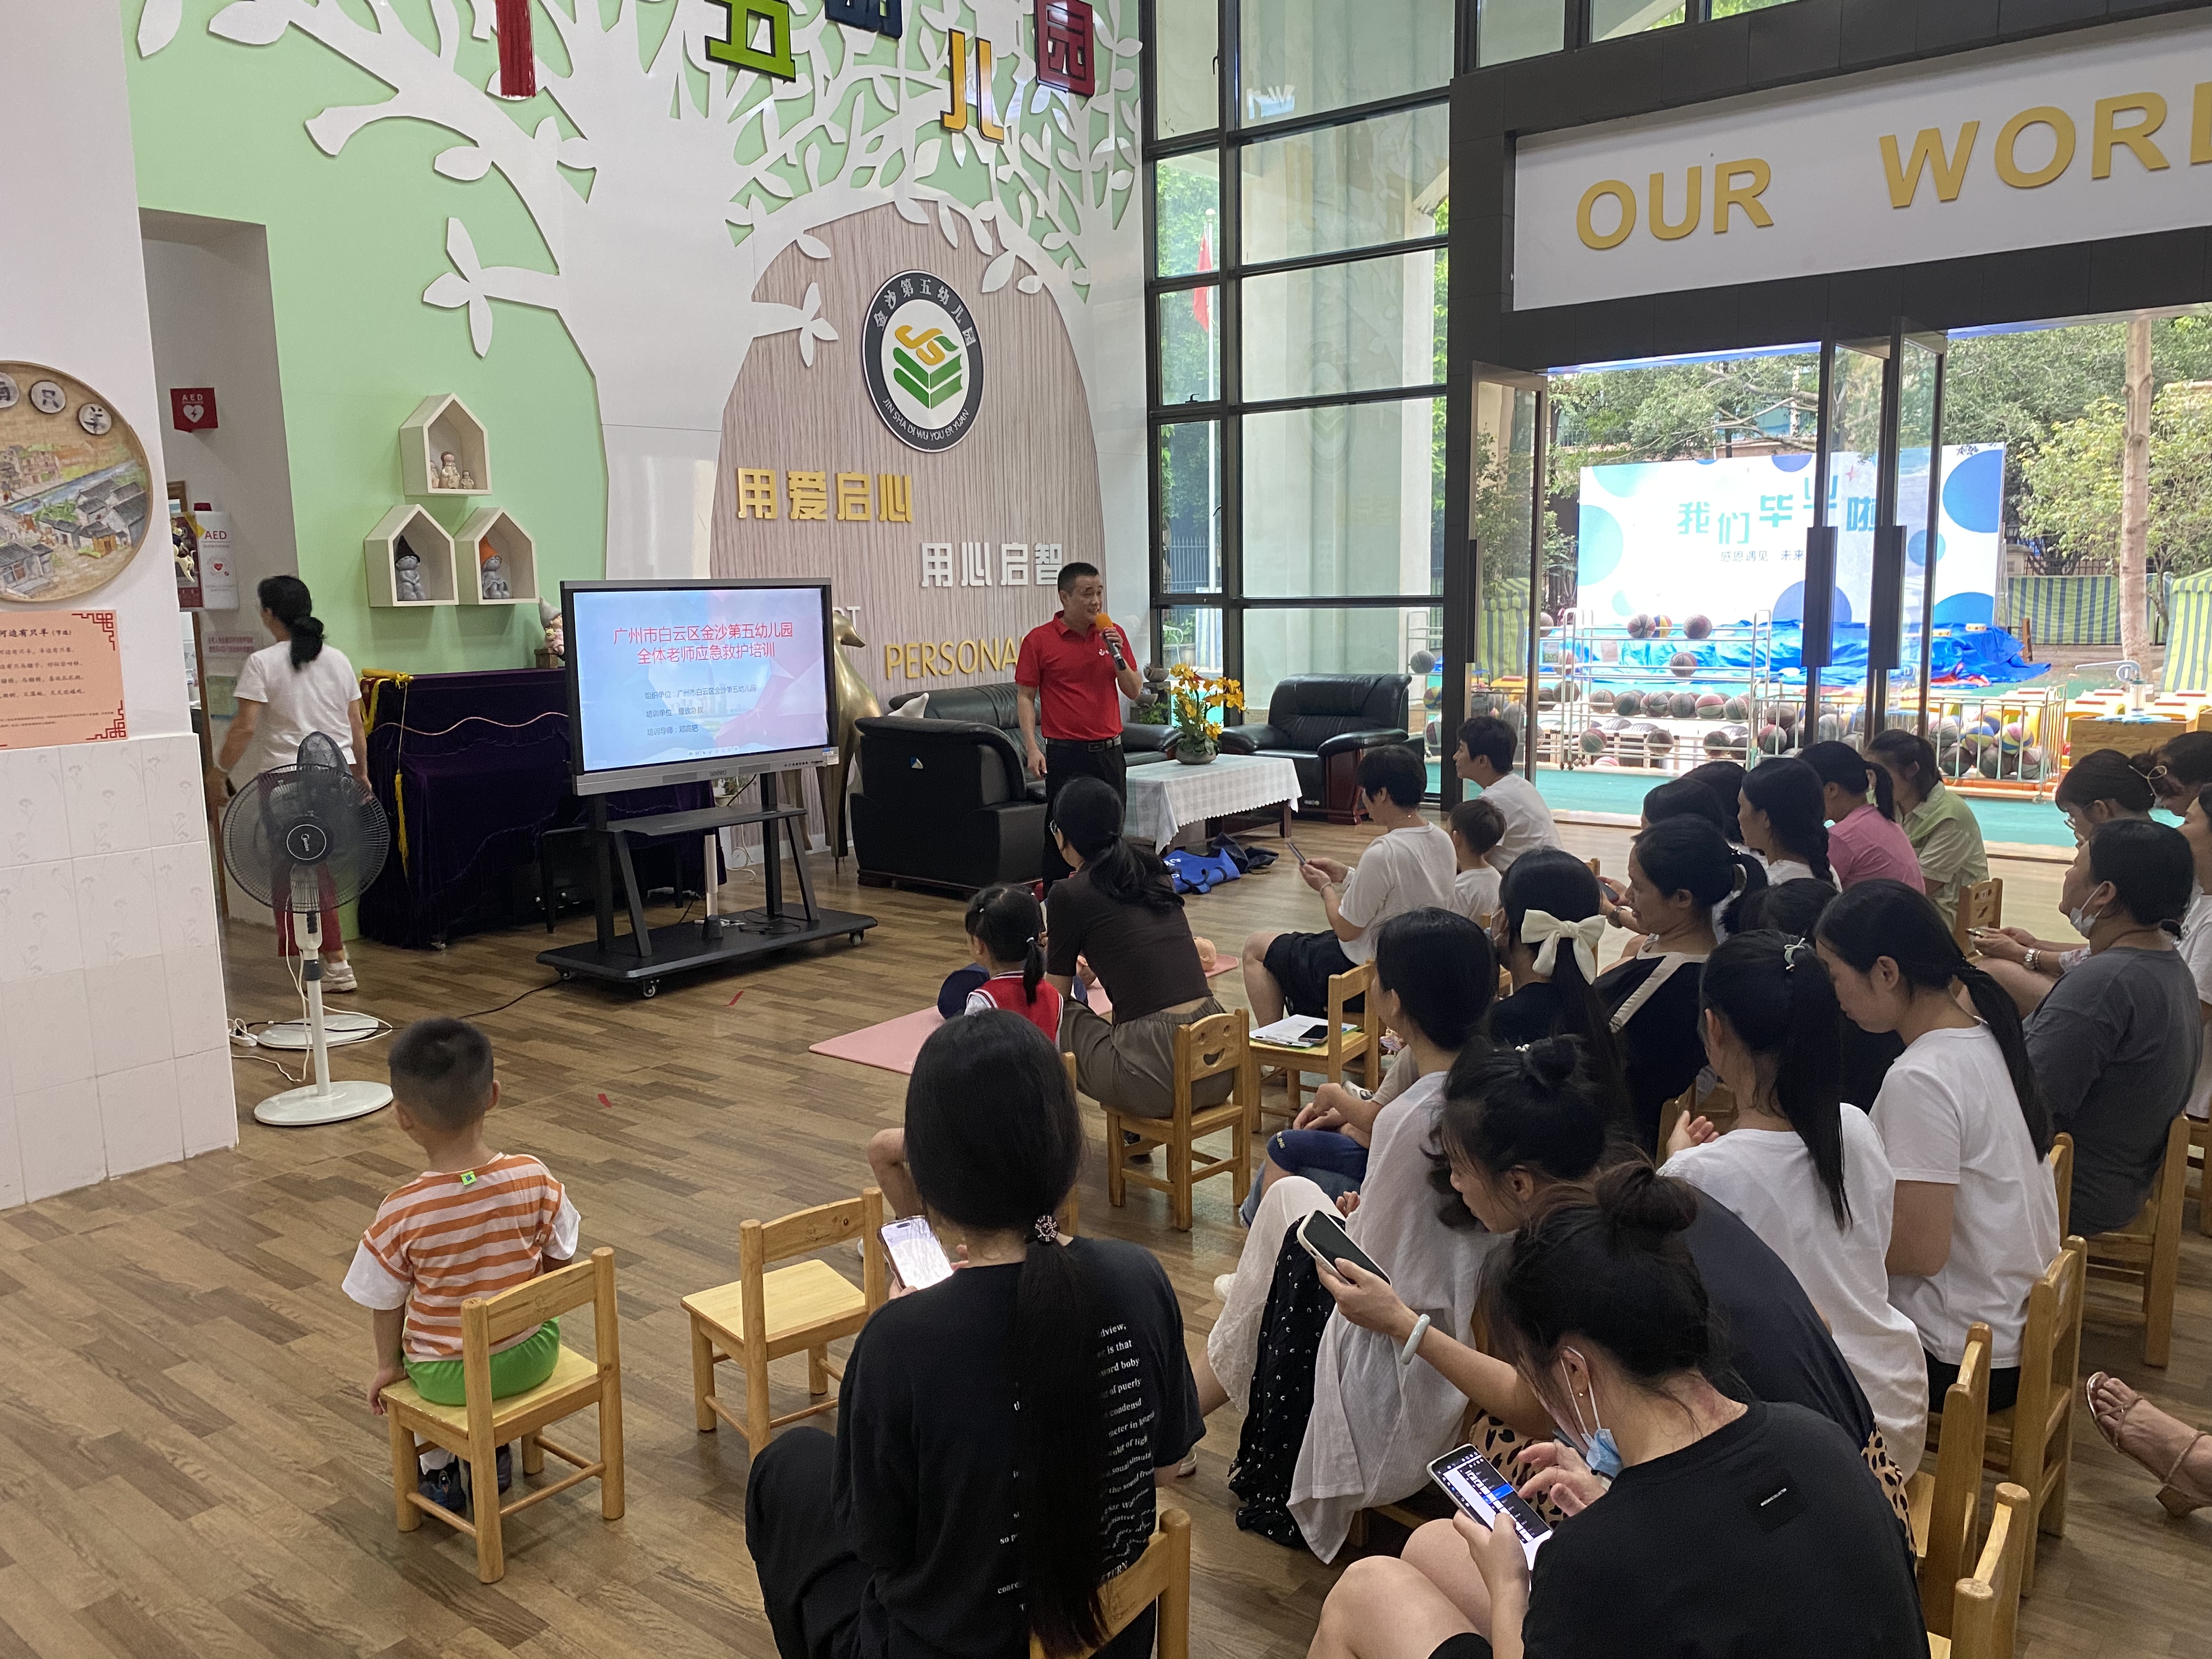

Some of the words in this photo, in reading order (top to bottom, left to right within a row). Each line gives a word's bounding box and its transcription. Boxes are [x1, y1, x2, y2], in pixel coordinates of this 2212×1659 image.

[1576, 157, 1774, 250] OUR
[873, 278, 976, 347] 金沙第五幼儿园
[883, 398, 895, 414] JIN
[892, 412, 906, 430] SHA
[907, 424, 915, 436] DI
[916, 430, 929, 441] WU
[930, 430, 944, 441] YOU
[945, 426, 954, 437] ER
[953, 408, 969, 431] YUAN
[737, 467, 913, 522] 用爱启心
[204, 531, 228, 540] AED
[922, 542, 1063, 588] 用心启智
[1721, 550, 1768, 562] 感恩遇见
[613, 622, 793, 645] 广州市白云区金沙第五幼儿园
[637, 641, 775, 665] 全体老师应急救护培训
[885, 637, 1025, 680] PERSONA
[1107, 1346, 1114, 1355] is
[1116, 1340, 1132, 1351] that
[1121, 1358, 1139, 1369] boby
[1110, 1385, 1116, 1395] of
[1108, 1424, 1128, 1438] meter
[1126, 1439, 1133, 1448] of
[1000, 1536, 1009, 1544] so
